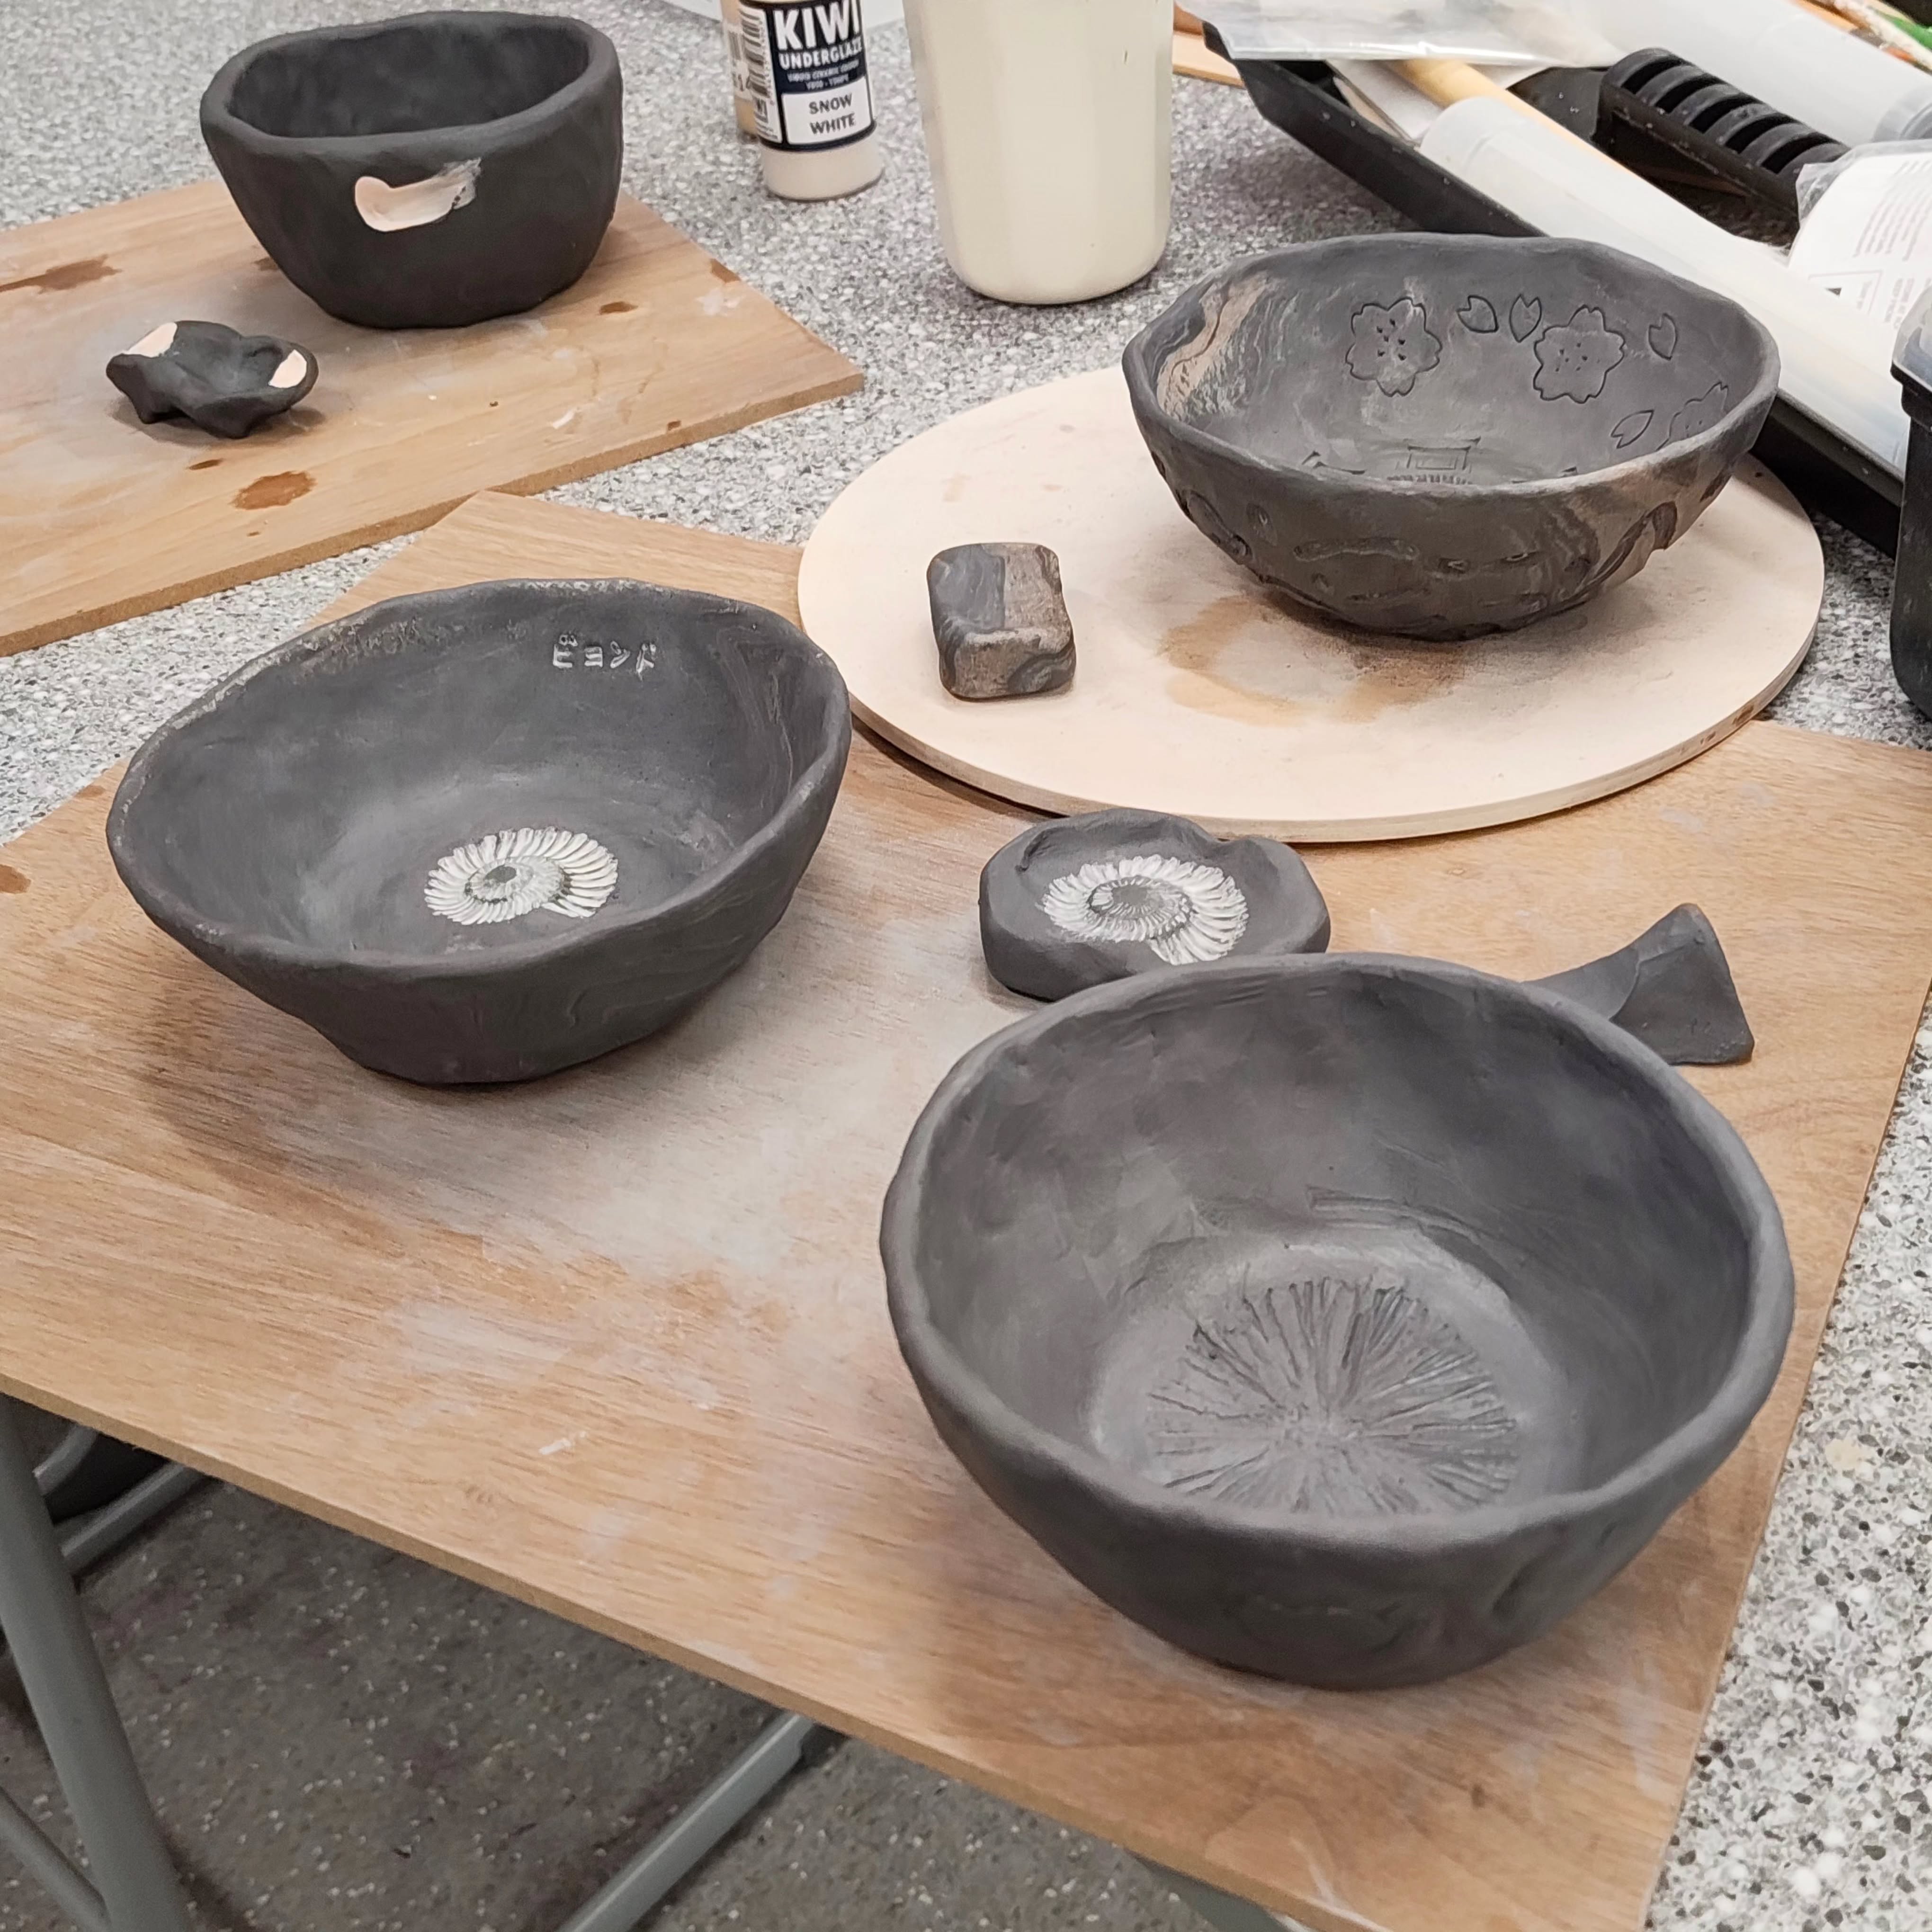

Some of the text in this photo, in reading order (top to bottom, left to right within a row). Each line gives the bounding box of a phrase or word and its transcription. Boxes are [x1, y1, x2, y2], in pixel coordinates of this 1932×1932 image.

[773, 0, 860, 51] KIWI
[809, 93, 852, 115] SNOW
[810, 112, 855, 135] WHITE
